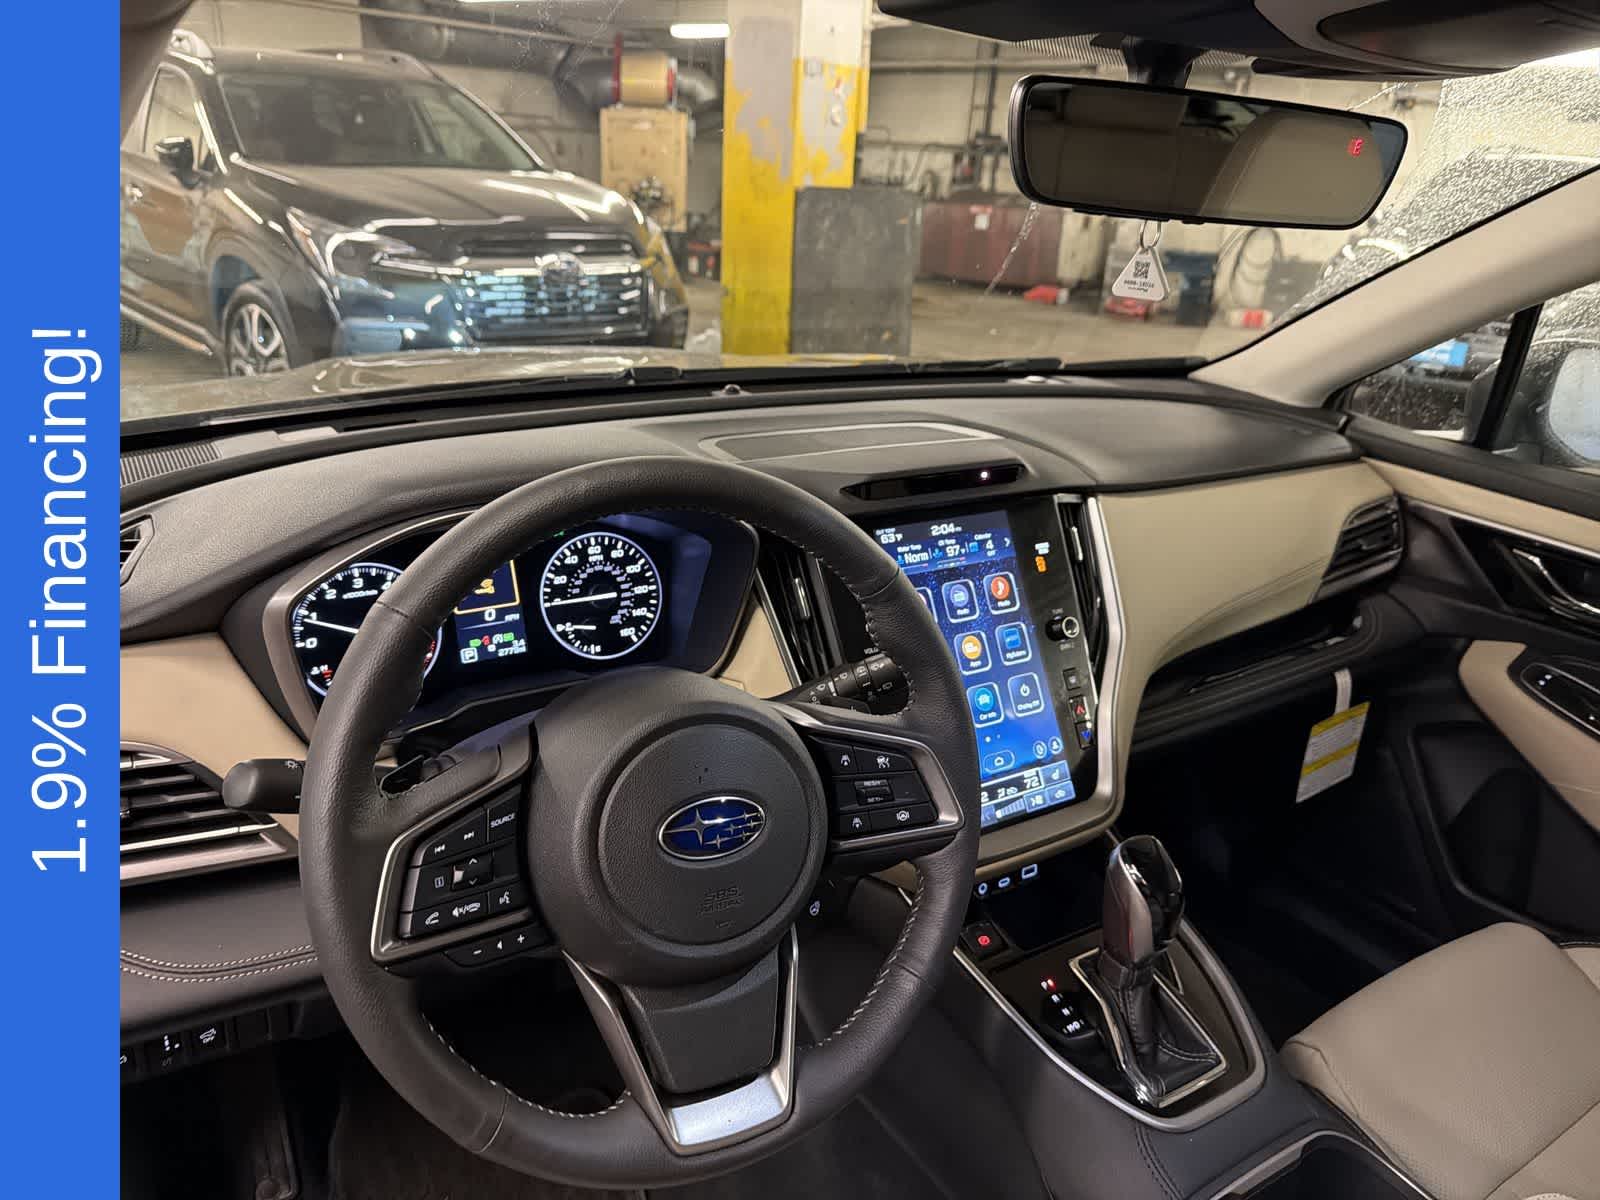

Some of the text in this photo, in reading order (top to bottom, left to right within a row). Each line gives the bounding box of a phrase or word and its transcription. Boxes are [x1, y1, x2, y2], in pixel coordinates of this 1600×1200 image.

[564, 555, 578, 564] 40
[904, 552, 929, 564] Norm
[626, 564, 641, 573] 100
[352, 578, 364, 588] 3
[553, 575, 567, 584] 20
[325, 589, 337, 600] 2
[632, 607, 647, 617] 140
[305, 637, 318, 648] 0
[1023, 777, 1040, 789] 72
[490, 813, 515, 828] SOURCE
